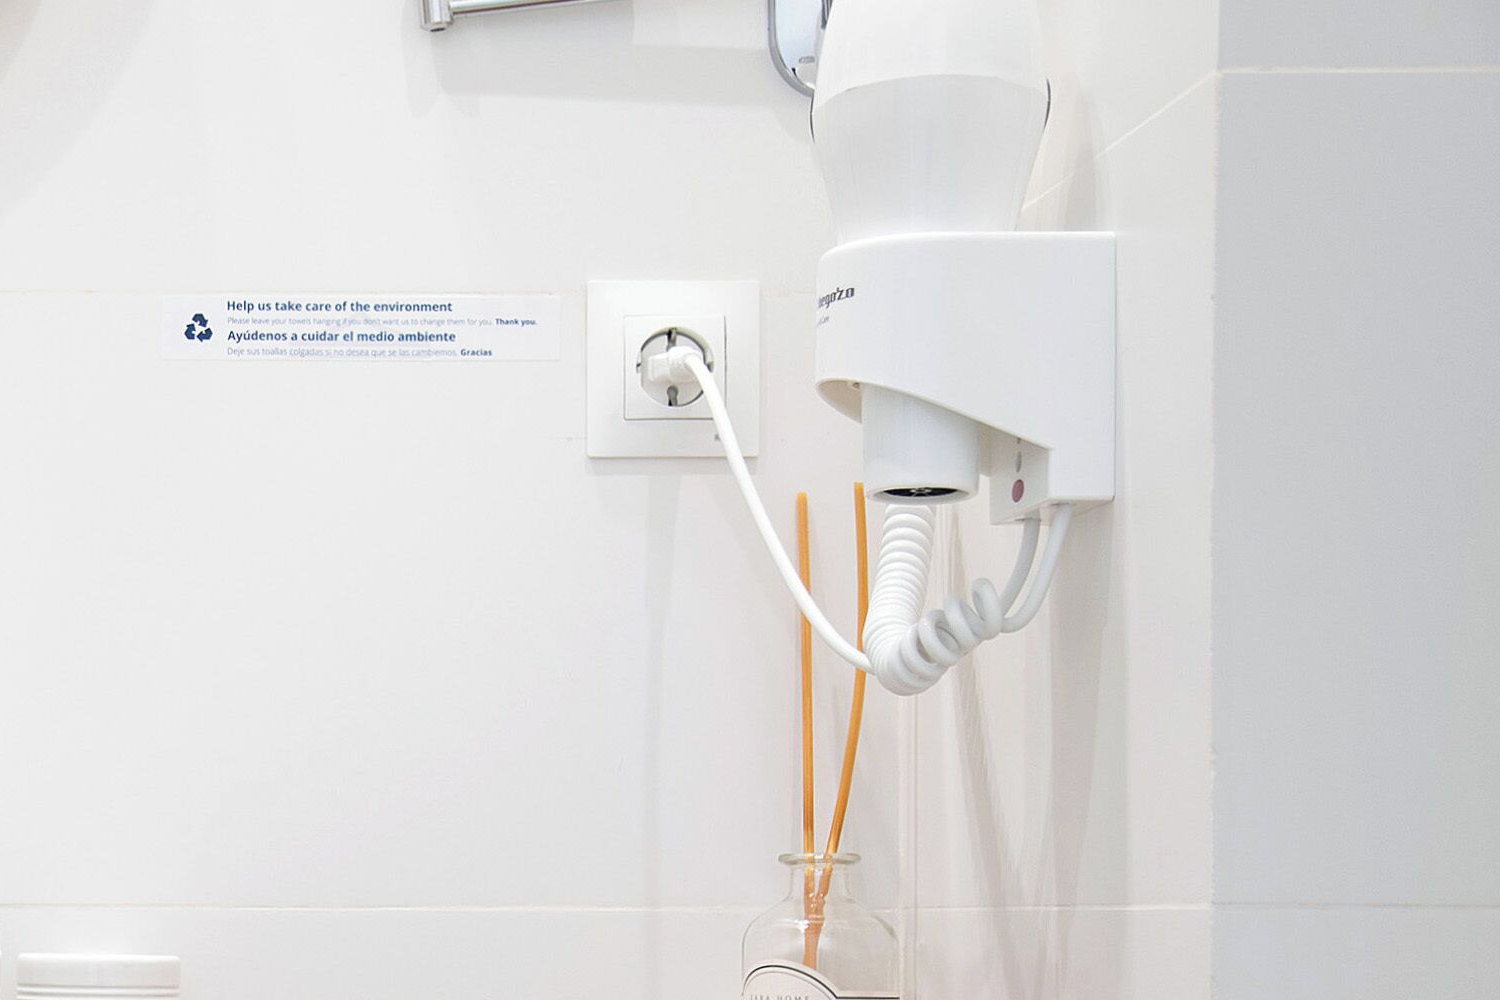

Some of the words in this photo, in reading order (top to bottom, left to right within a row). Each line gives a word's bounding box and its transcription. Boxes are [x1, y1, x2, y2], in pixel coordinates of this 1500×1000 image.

[227, 300, 255, 314] Help
[258, 302, 272, 312] us
[275, 301, 302, 312] take
[305, 302, 332, 312] care
[335, 301, 349, 312] of
[350, 301, 371, 312] the
[373, 301, 453, 312] environment
[227, 317, 250, 325] Please
[251, 317, 270, 325] leave
[270, 318, 287, 327] your
[288, 317, 312, 325] towels
[313, 317, 340, 327] hanging
[382, 318, 400, 326] want
[411, 318, 418, 326] to
[420, 317, 445, 327] change
[447, 317, 465, 326] them
[467, 317, 477, 326] for
[495, 317, 519, 326] Thank
[521, 319, 538, 328] you.
[227, 330, 287, 344] Ayúdenos
[290, 332, 298, 342] a
[301, 331, 340, 342] cuidar
[342, 331, 354, 342] el
[357, 331, 395, 342] medio
[398, 331, 457, 342] ambiente
[227, 347, 246, 357] Deje
[262, 347, 288, 356] toallas
[289, 347, 324, 357] colgadas
[460, 348, 493, 357] Gracias
